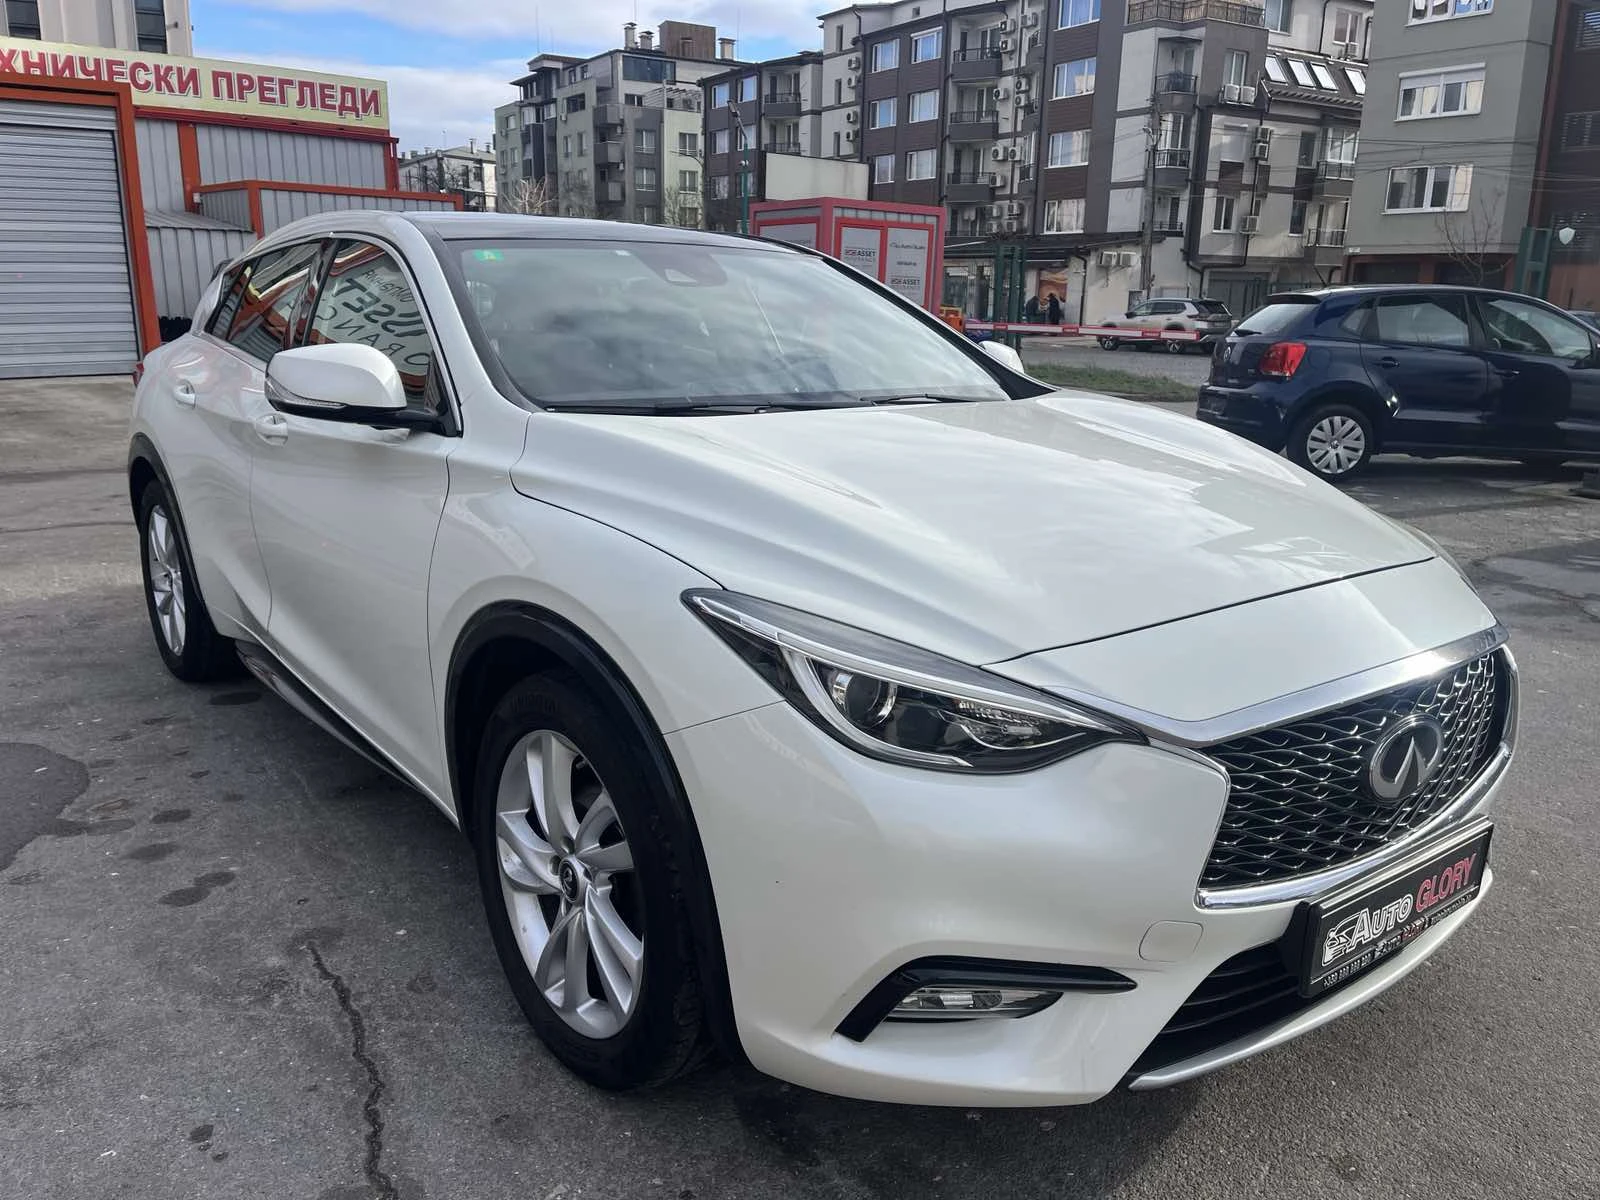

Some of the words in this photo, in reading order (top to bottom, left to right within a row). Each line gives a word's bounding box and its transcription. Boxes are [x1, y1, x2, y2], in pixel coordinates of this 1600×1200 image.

[211, 70, 381, 119] ПРЕГЛЕДИ
[1346, 893, 1414, 949] AUTO
[1415, 852, 1477, 912] GLORY
